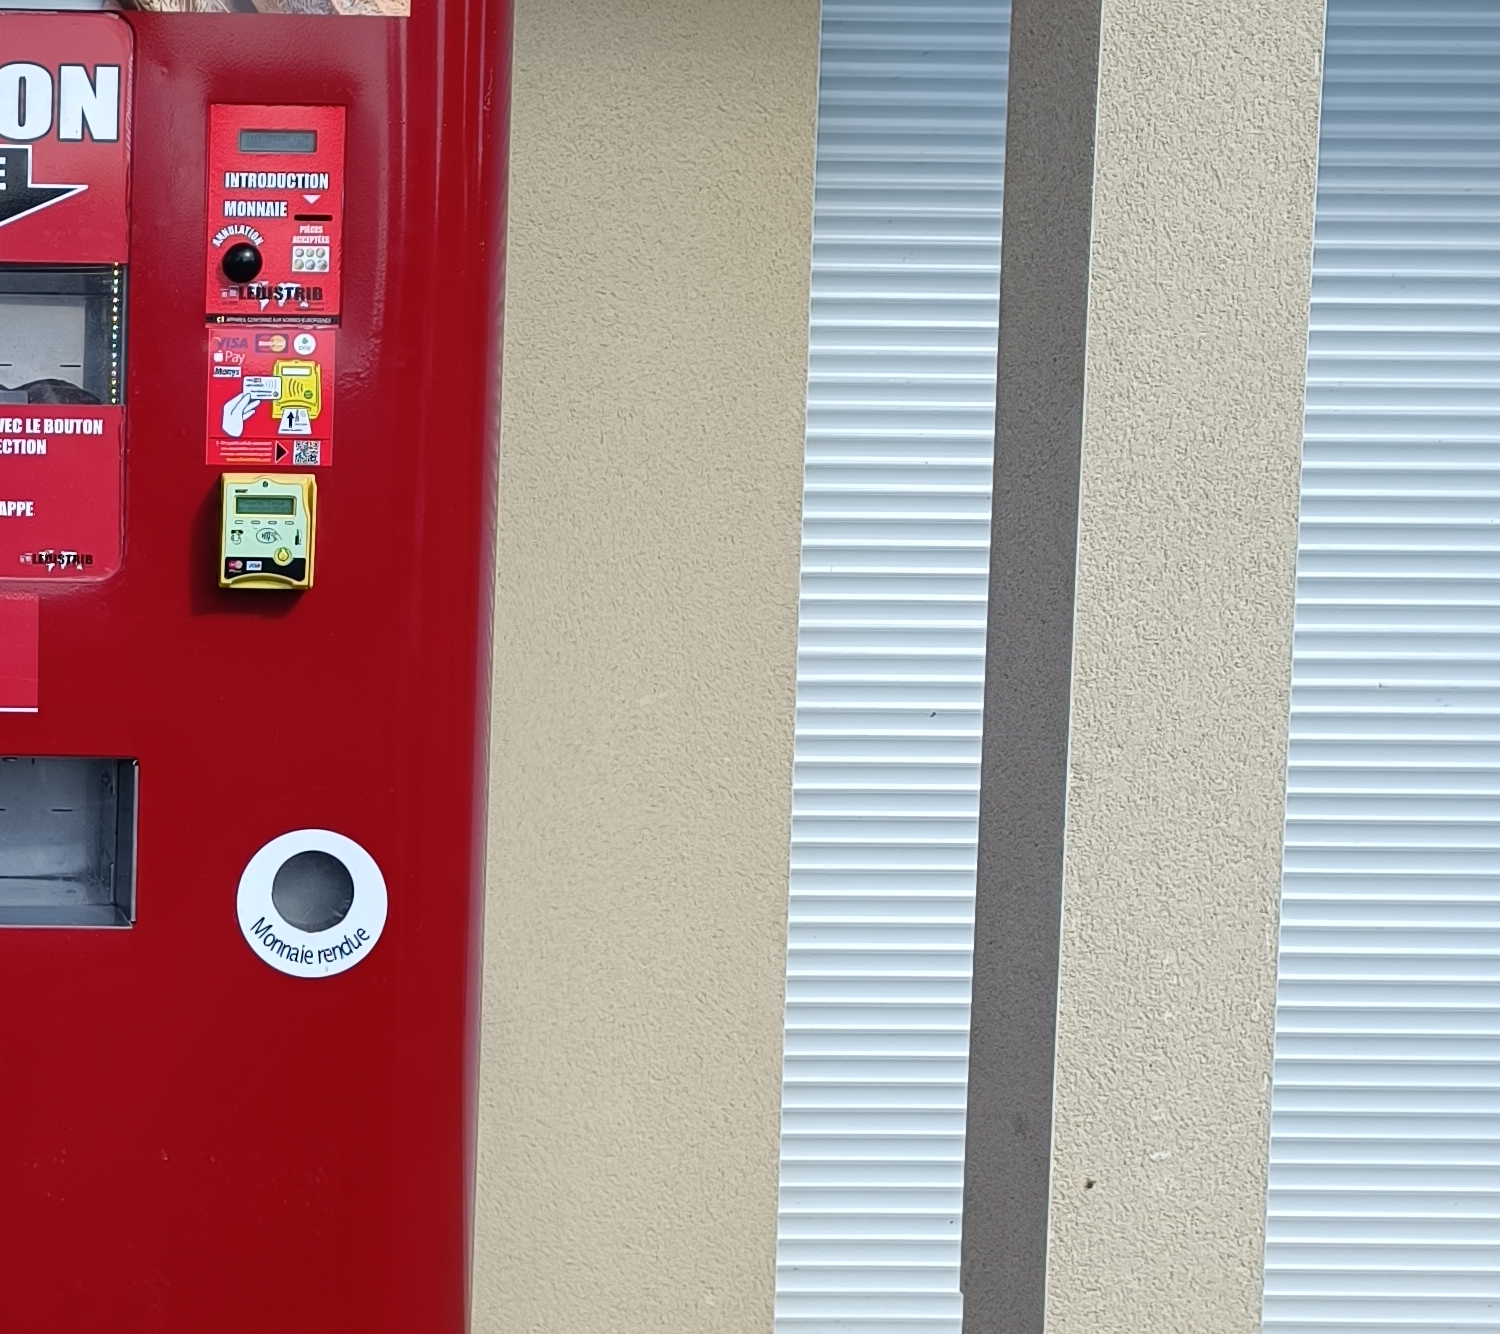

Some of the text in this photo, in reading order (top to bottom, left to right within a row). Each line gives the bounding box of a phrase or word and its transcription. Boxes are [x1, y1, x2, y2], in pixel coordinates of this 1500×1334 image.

[224, 172, 329, 190] INTRODUCTION
[224, 200, 288, 217] MONNAIE
[212, 225, 264, 247] ANNULATION
[217, 337, 248, 349] VISA
[226, 351, 246, 365] Pay
[25, 418, 40, 434] LE
[44, 418, 103, 435] BOUTON
[250, 916, 371, 965] Monnaie rendue
